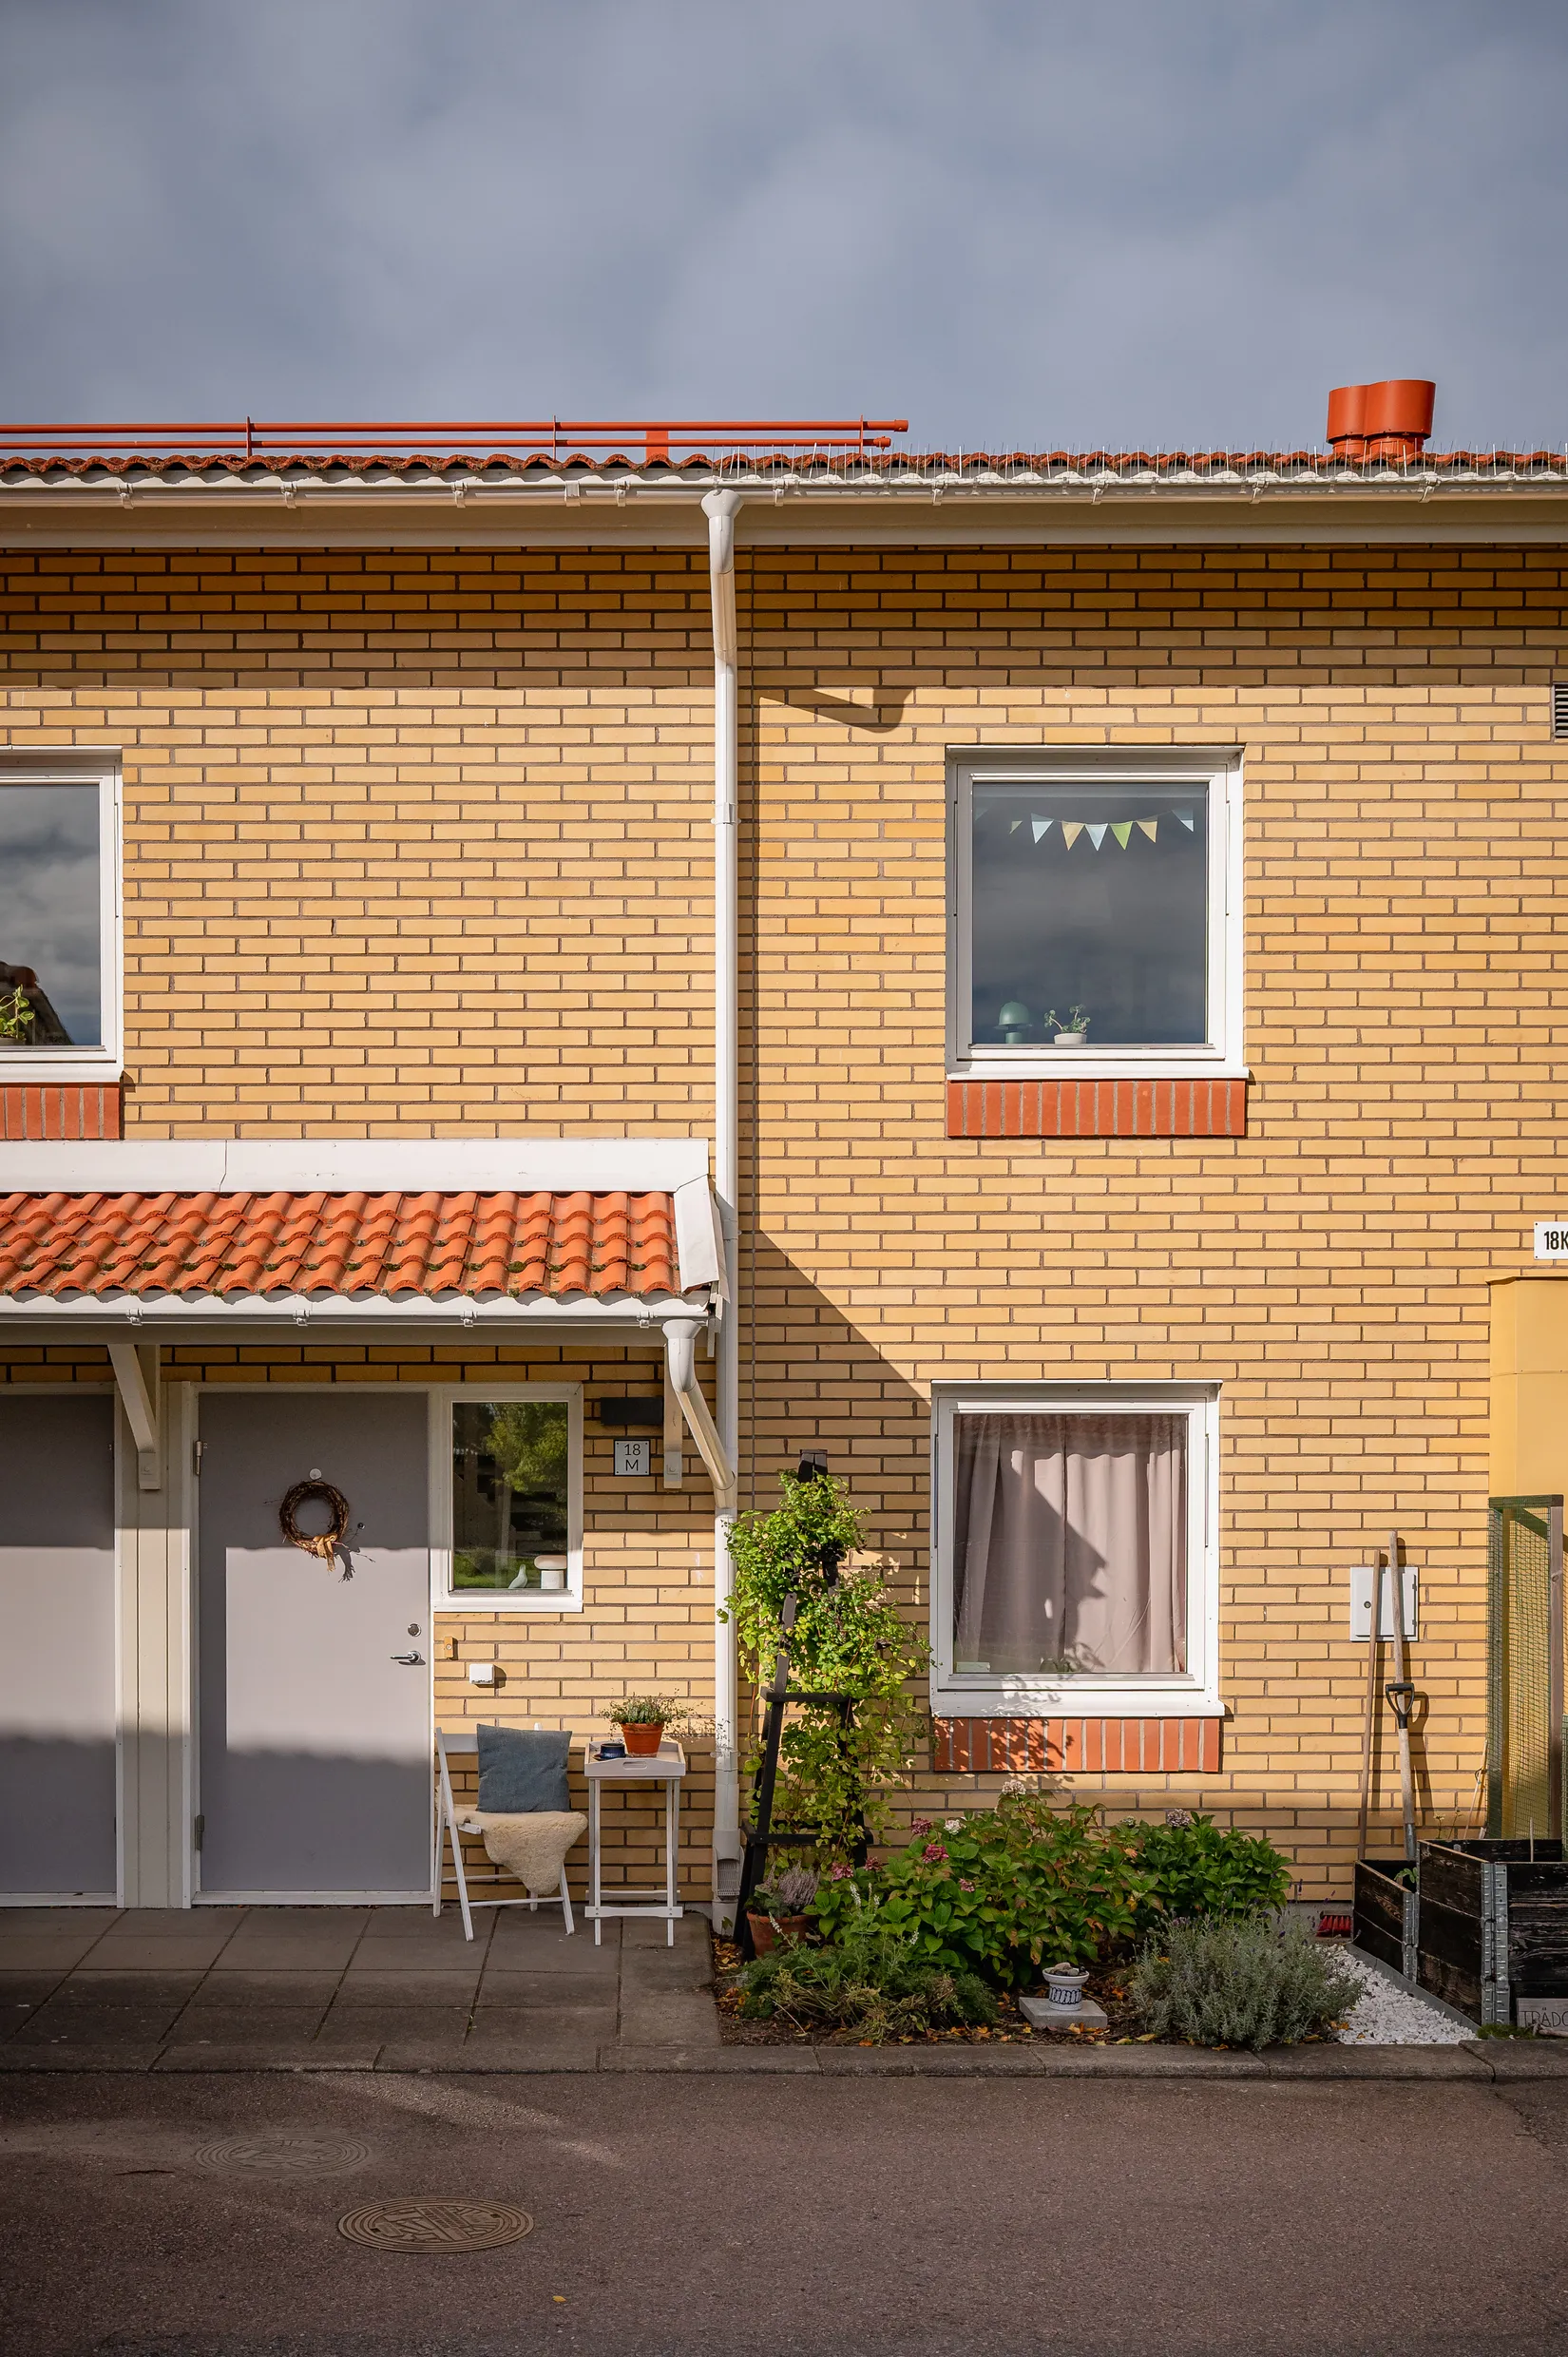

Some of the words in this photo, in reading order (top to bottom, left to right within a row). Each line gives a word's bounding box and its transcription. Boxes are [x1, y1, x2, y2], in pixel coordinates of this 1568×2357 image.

[1544, 1231, 1568, 1250] 18K
[624, 1444, 641, 1455] 18
[625, 1459, 639, 1471] M
